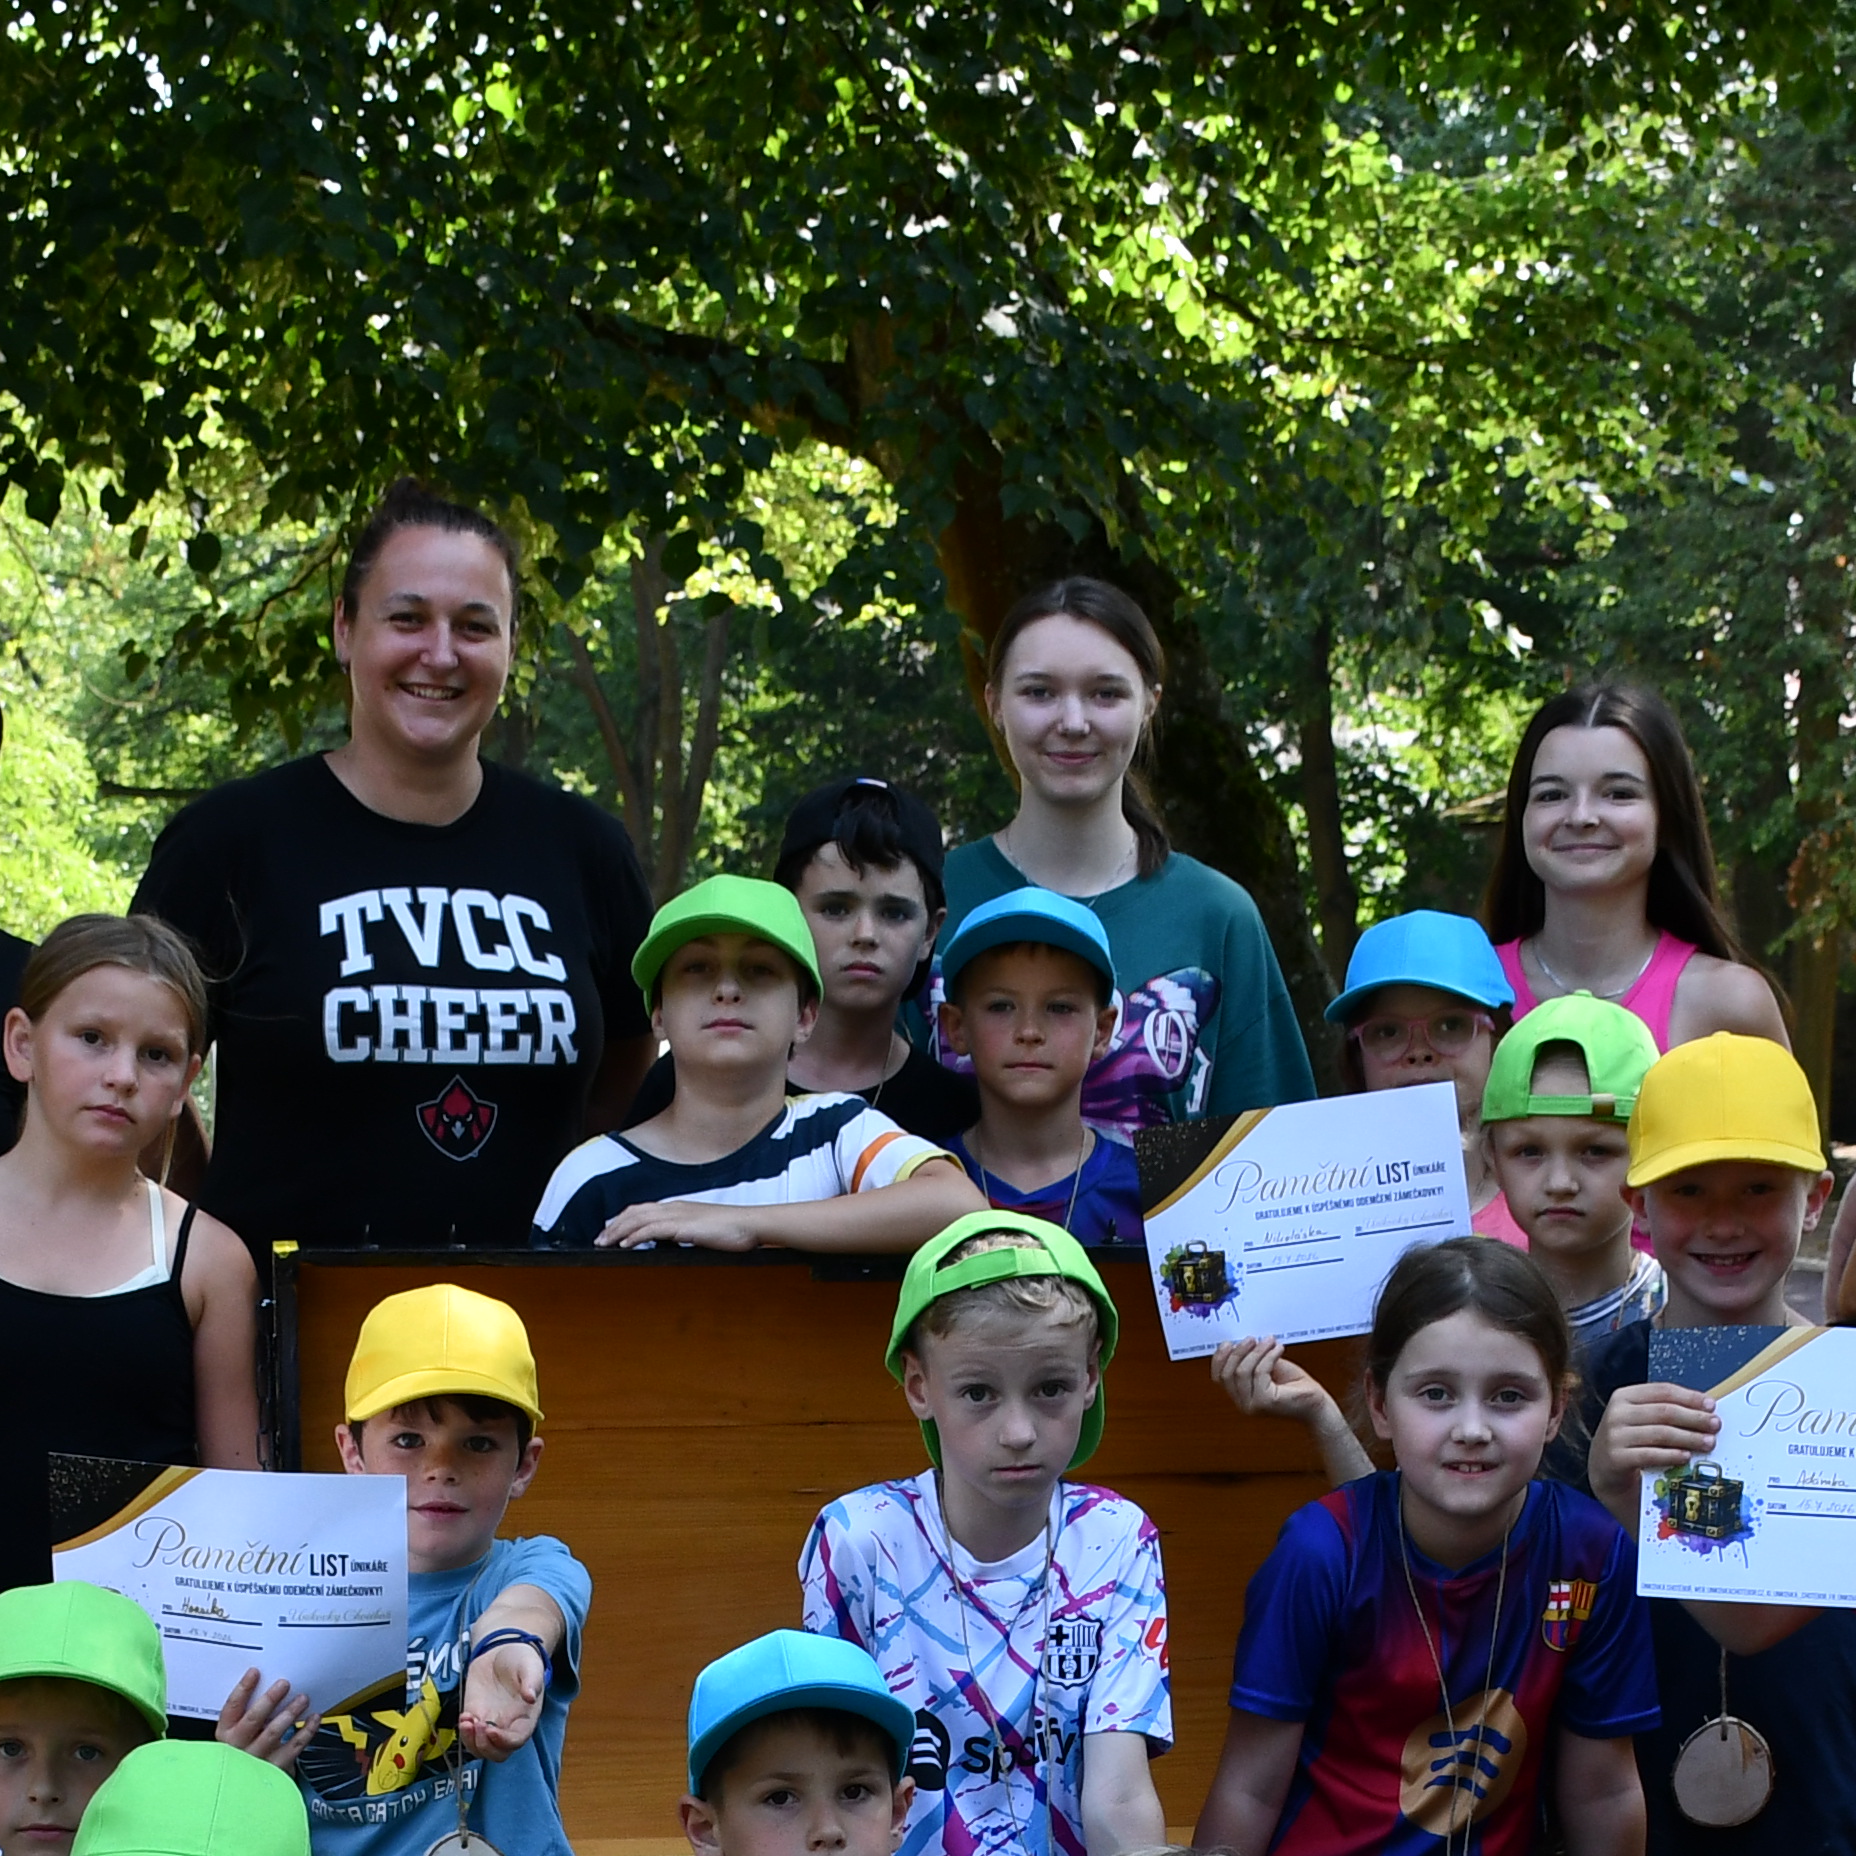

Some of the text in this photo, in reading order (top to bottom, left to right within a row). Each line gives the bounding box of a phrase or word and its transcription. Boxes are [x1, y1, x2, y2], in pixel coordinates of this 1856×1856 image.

[319, 887, 568, 983] TVCC
[322, 984, 579, 1065] CHEER
[1214, 1156, 1373, 1214] Pamětní
[1375, 1159, 1413, 1186] LIST
[132, 1515, 308, 1576] Pamětní
[309, 1554, 349, 1577] LIST
